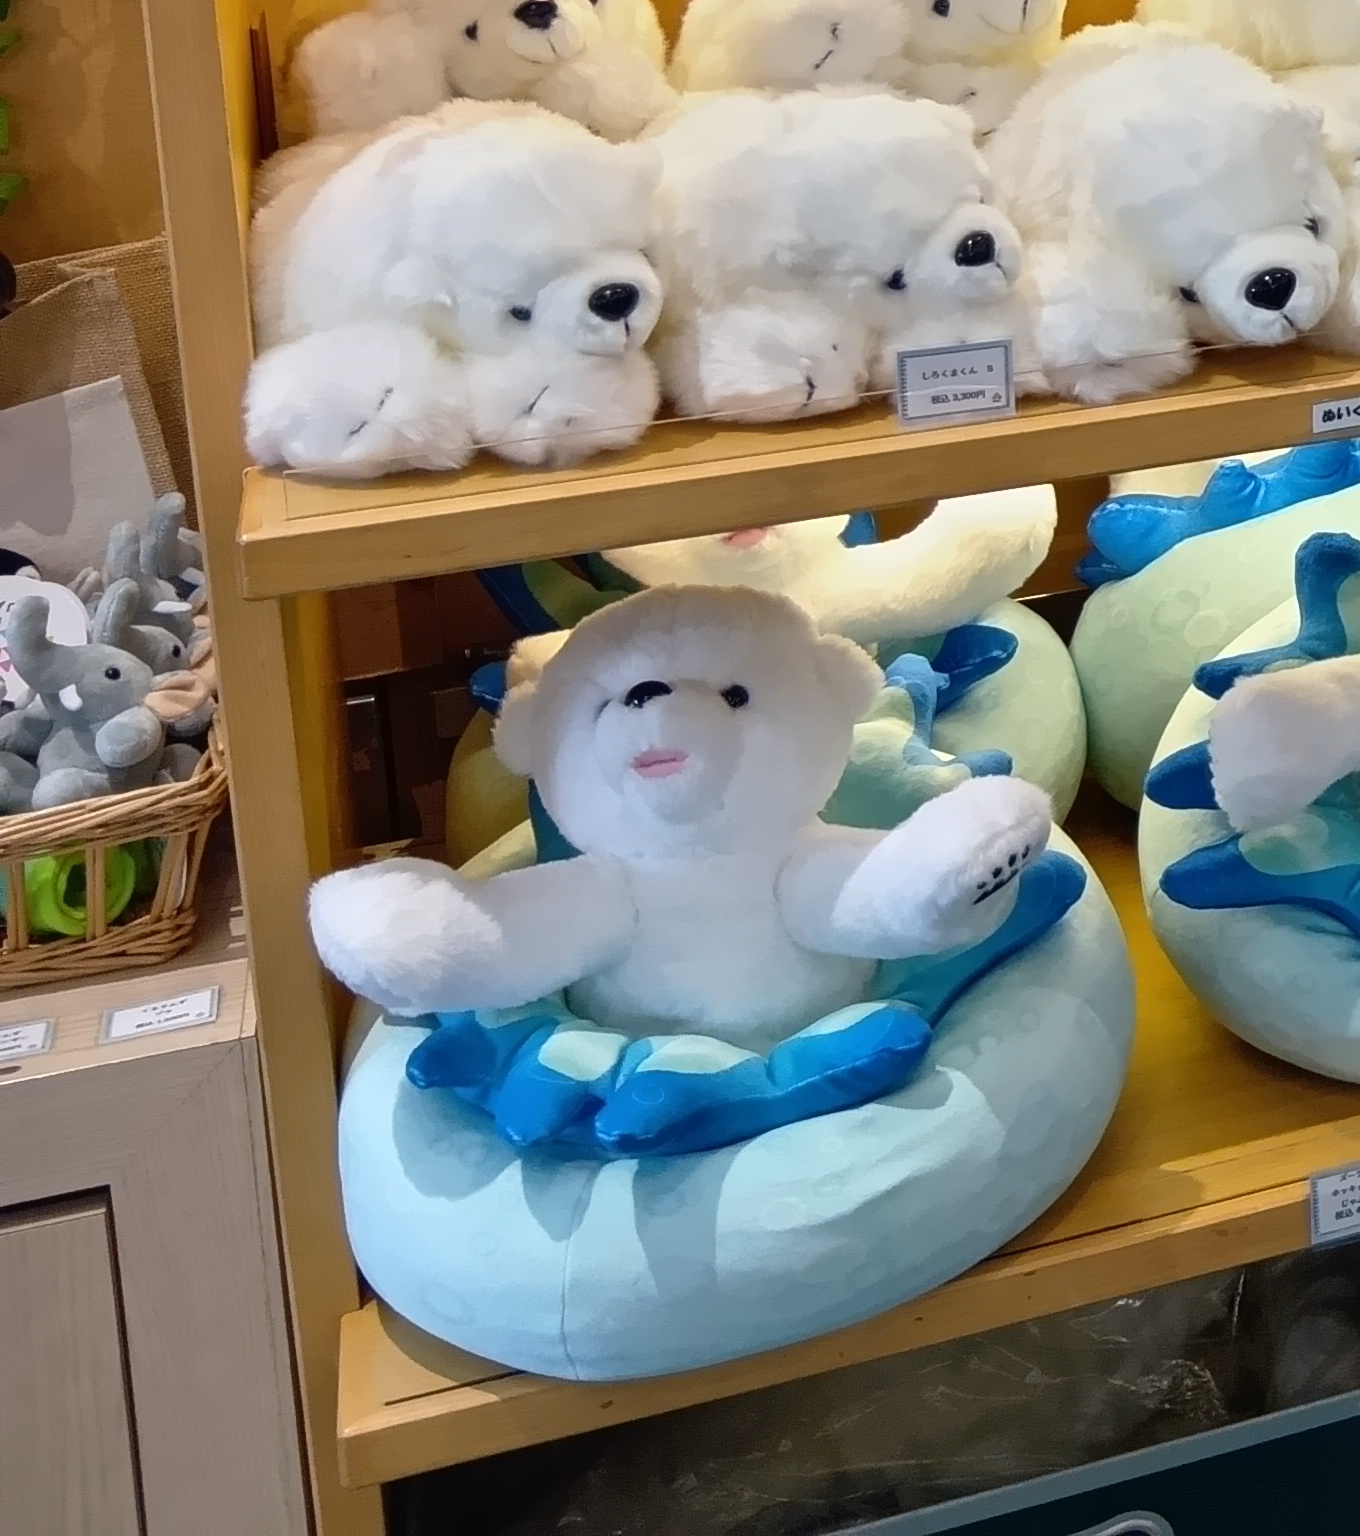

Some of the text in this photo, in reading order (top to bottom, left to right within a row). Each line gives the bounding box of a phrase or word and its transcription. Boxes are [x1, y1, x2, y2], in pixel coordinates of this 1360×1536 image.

[922, 366, 978, 381] しろくまくん
[1335, 1208, 1354, 1221] 税込
